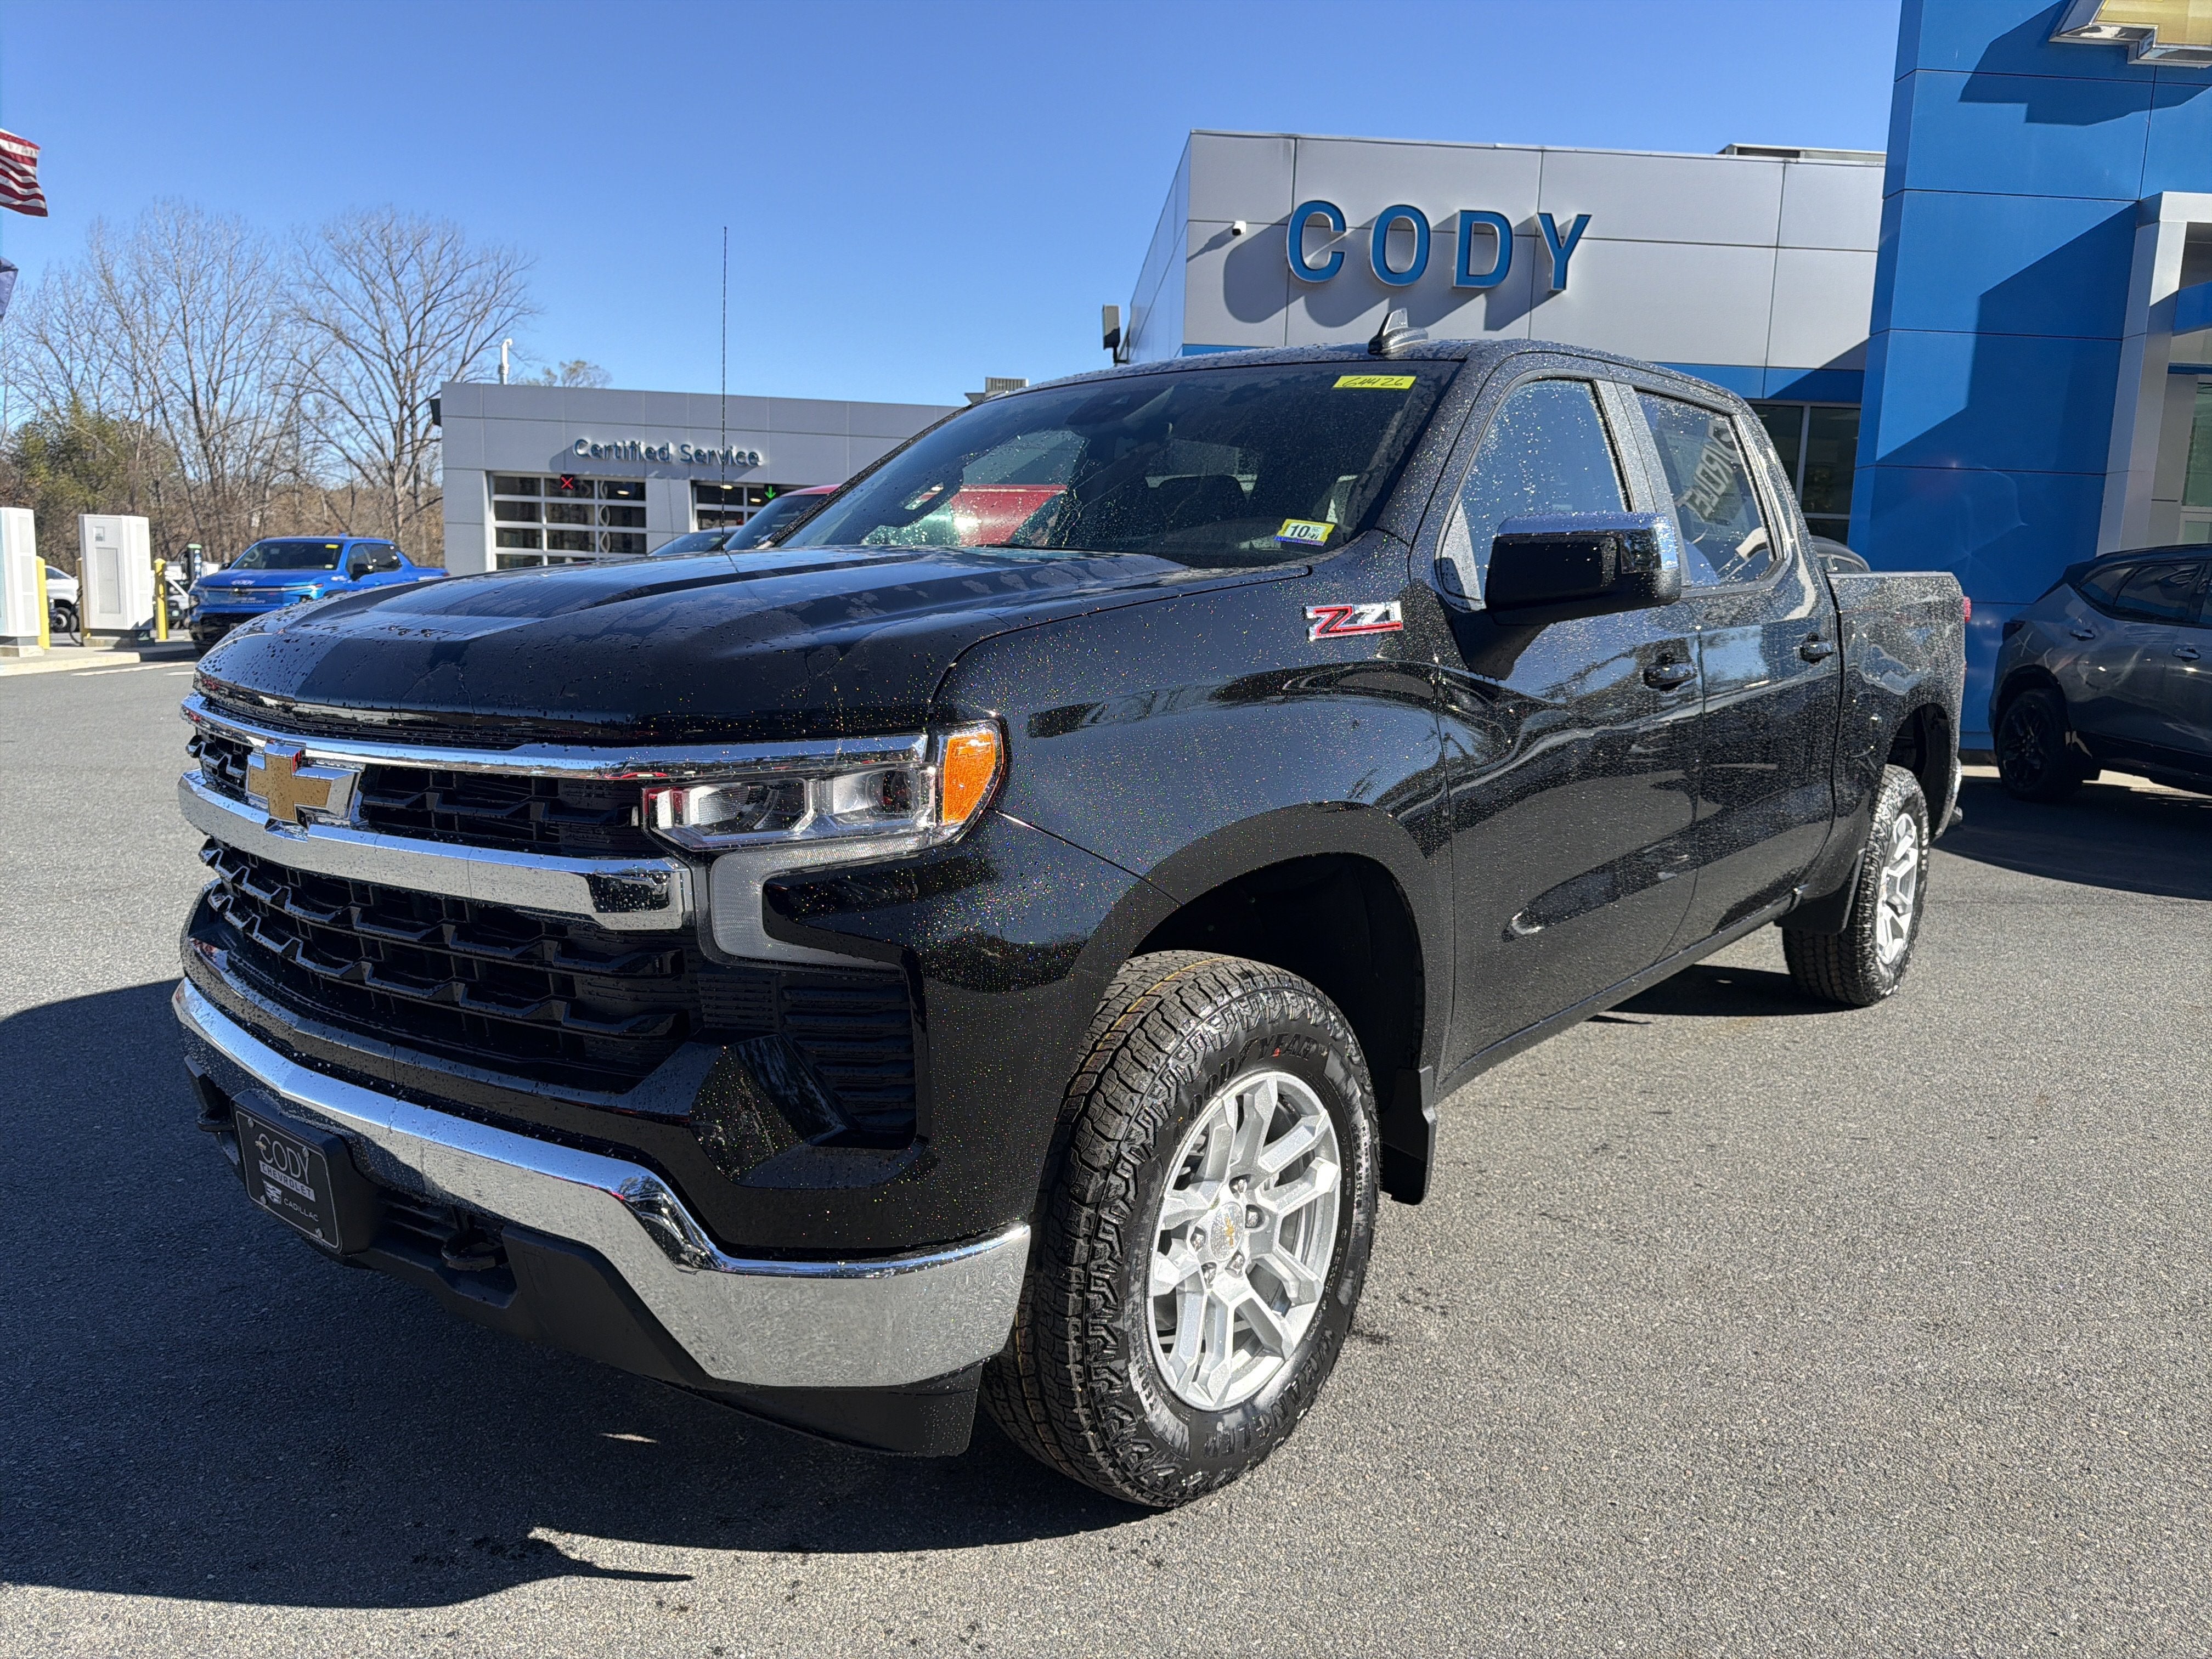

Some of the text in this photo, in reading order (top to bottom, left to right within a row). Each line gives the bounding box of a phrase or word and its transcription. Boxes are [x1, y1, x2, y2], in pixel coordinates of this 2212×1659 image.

[1286, 200, 1592, 290] CODY
[573, 438, 763, 466] Certified Service
[1289, 524, 1311, 538] 10
[1306, 601, 1403, 641] Z71
[258, 1133, 309, 1185] CODY
[262, 1164, 313, 1198] CHEVROLET
[283, 1198, 319, 1222] CADILLAC
